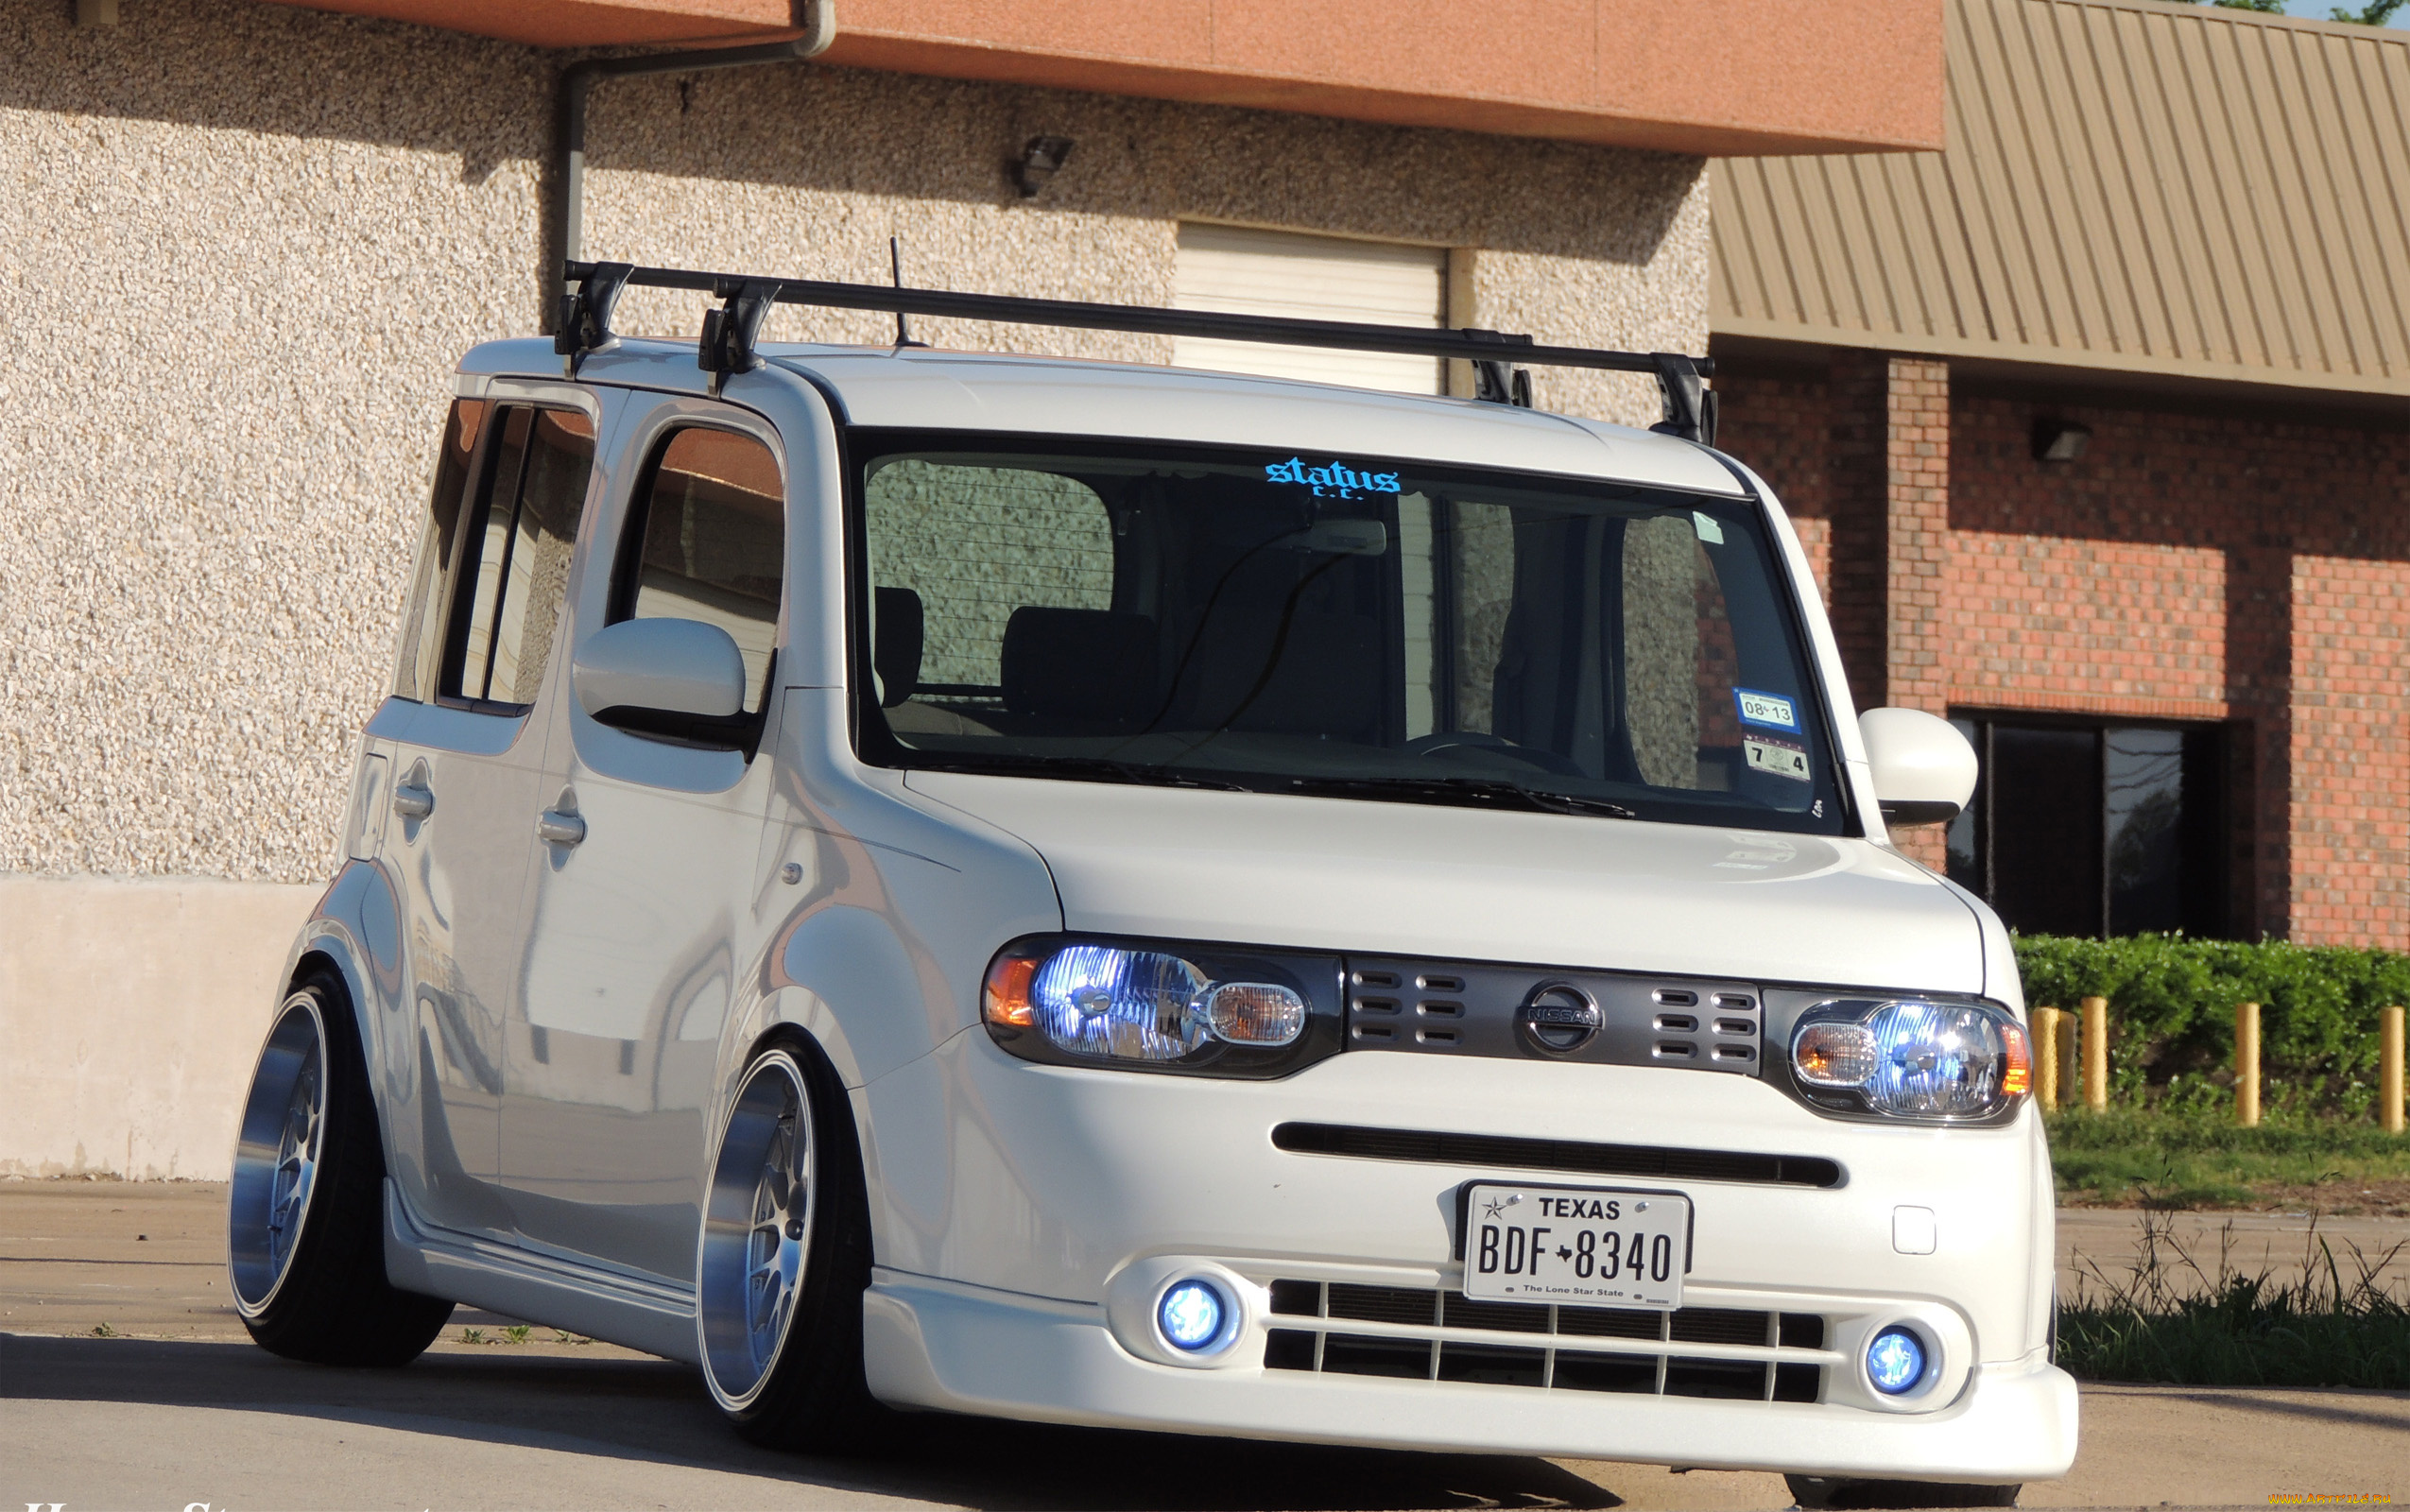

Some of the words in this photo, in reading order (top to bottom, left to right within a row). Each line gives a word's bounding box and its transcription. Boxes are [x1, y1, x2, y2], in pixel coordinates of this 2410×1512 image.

[1265, 456, 1401, 492] status
[1745, 701, 1764, 716] 08
[1772, 706, 1791, 721] 13
[1751, 747, 1763, 763] 7
[1793, 756, 1804, 772] 4
[1527, 1008, 1596, 1024] NISSAN
[1539, 1196, 1621, 1221] TEXAS
[1478, 1225, 1552, 1276] BDF
[1575, 1229, 1672, 1282] 8340
[1523, 1284, 1542, 1293] The
[1545, 1285, 1570, 1294] Lone
[1573, 1287, 1594, 1296] Star
[1596, 1288, 1624, 1297] State
